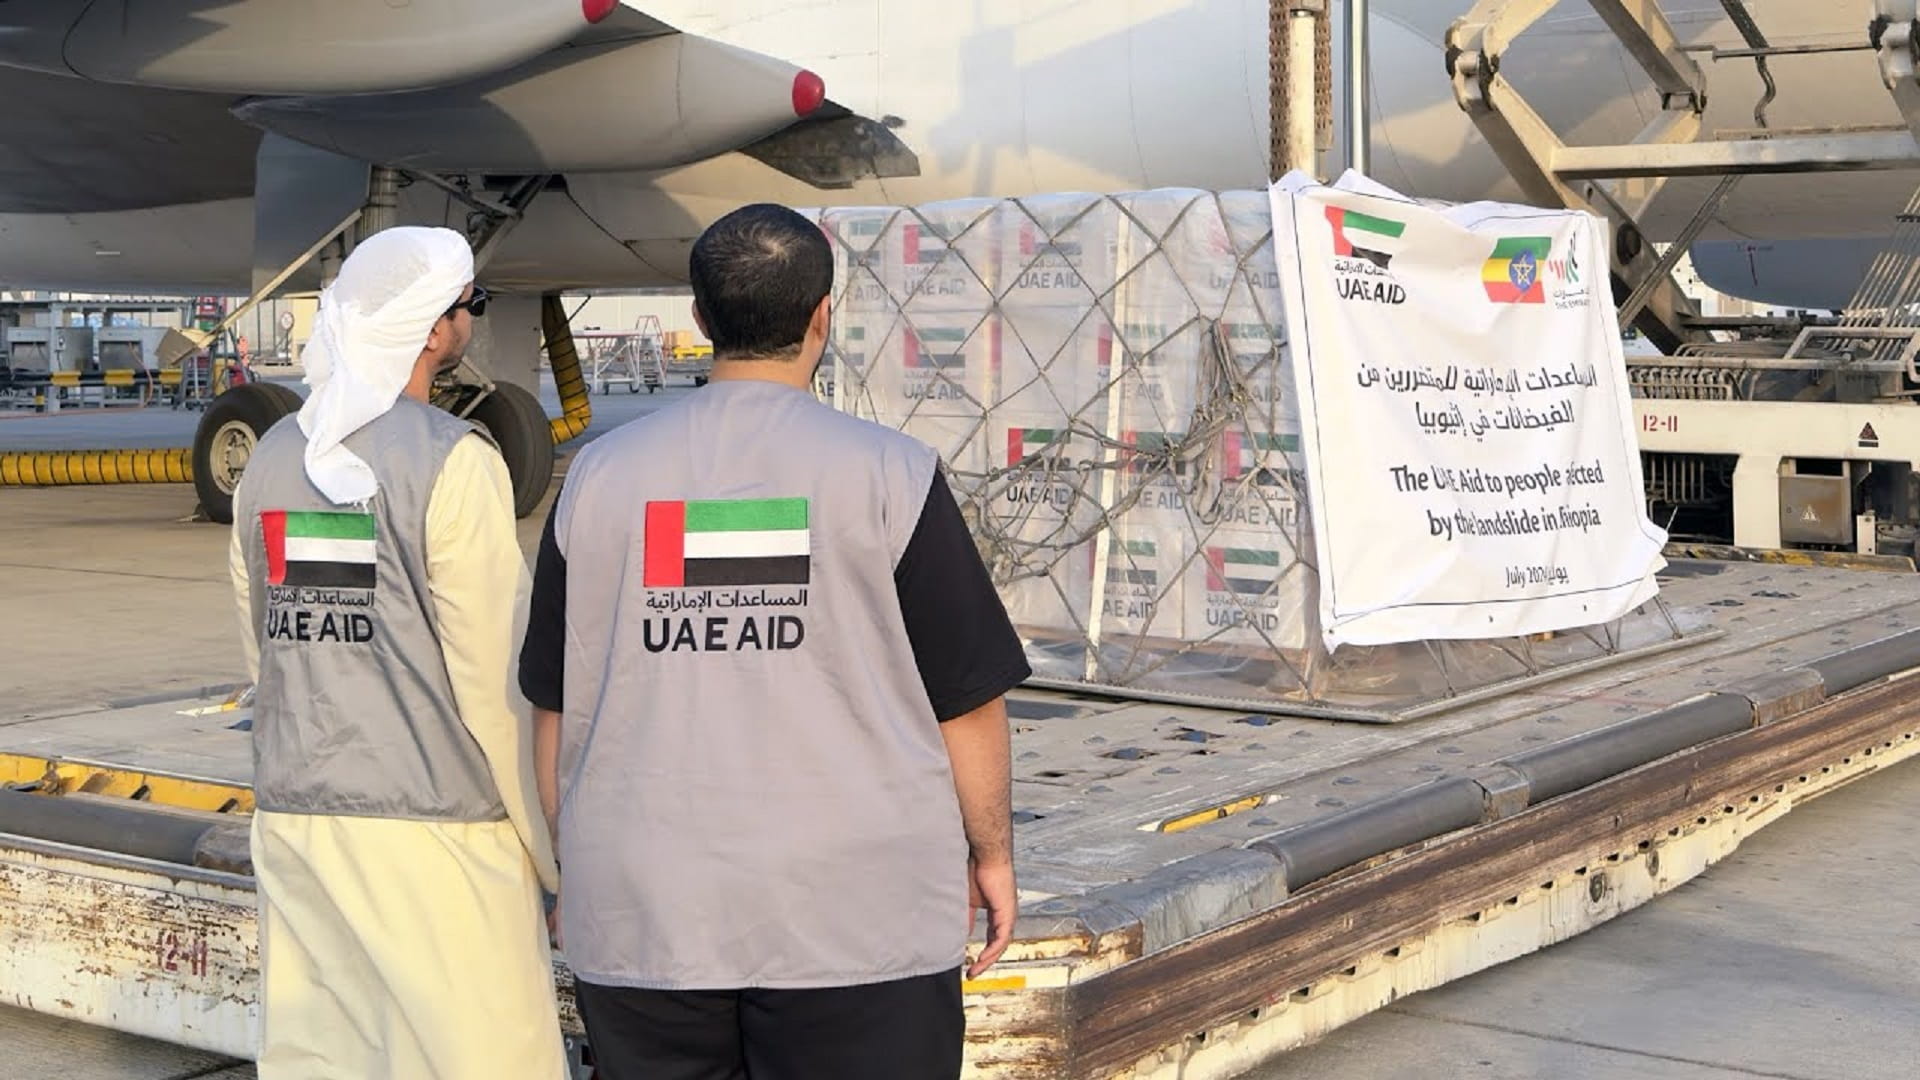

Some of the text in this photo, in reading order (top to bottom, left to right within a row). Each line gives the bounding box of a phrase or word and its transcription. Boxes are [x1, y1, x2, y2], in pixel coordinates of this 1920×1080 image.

[1018, 272, 1081, 289] UAE AID
[1336, 278, 1406, 304] UAE AID
[1357, 362, 1380, 388] من
[1470, 408, 1490, 443] في
[1493, 400, 1575, 433] الفيضانات
[1643, 414, 1678, 433] 12-11
[1389, 464, 1429, 493] The
[1459, 468, 1486, 494] Aid
[1485, 473, 1503, 493] to
[1505, 463, 1561, 499] people
[1427, 509, 1452, 541] by
[1454, 507, 1475, 535] the
[1474, 508, 1541, 537] landslide
[1541, 506, 1558, 532] in
[1505, 565, 1526, 588] July
[645, 588, 808, 614] المساعدات الإماراتية
[1102, 599, 1124, 617] AE
[268, 607, 374, 643] UAE AID
[643, 615, 805, 653] UAE AID
